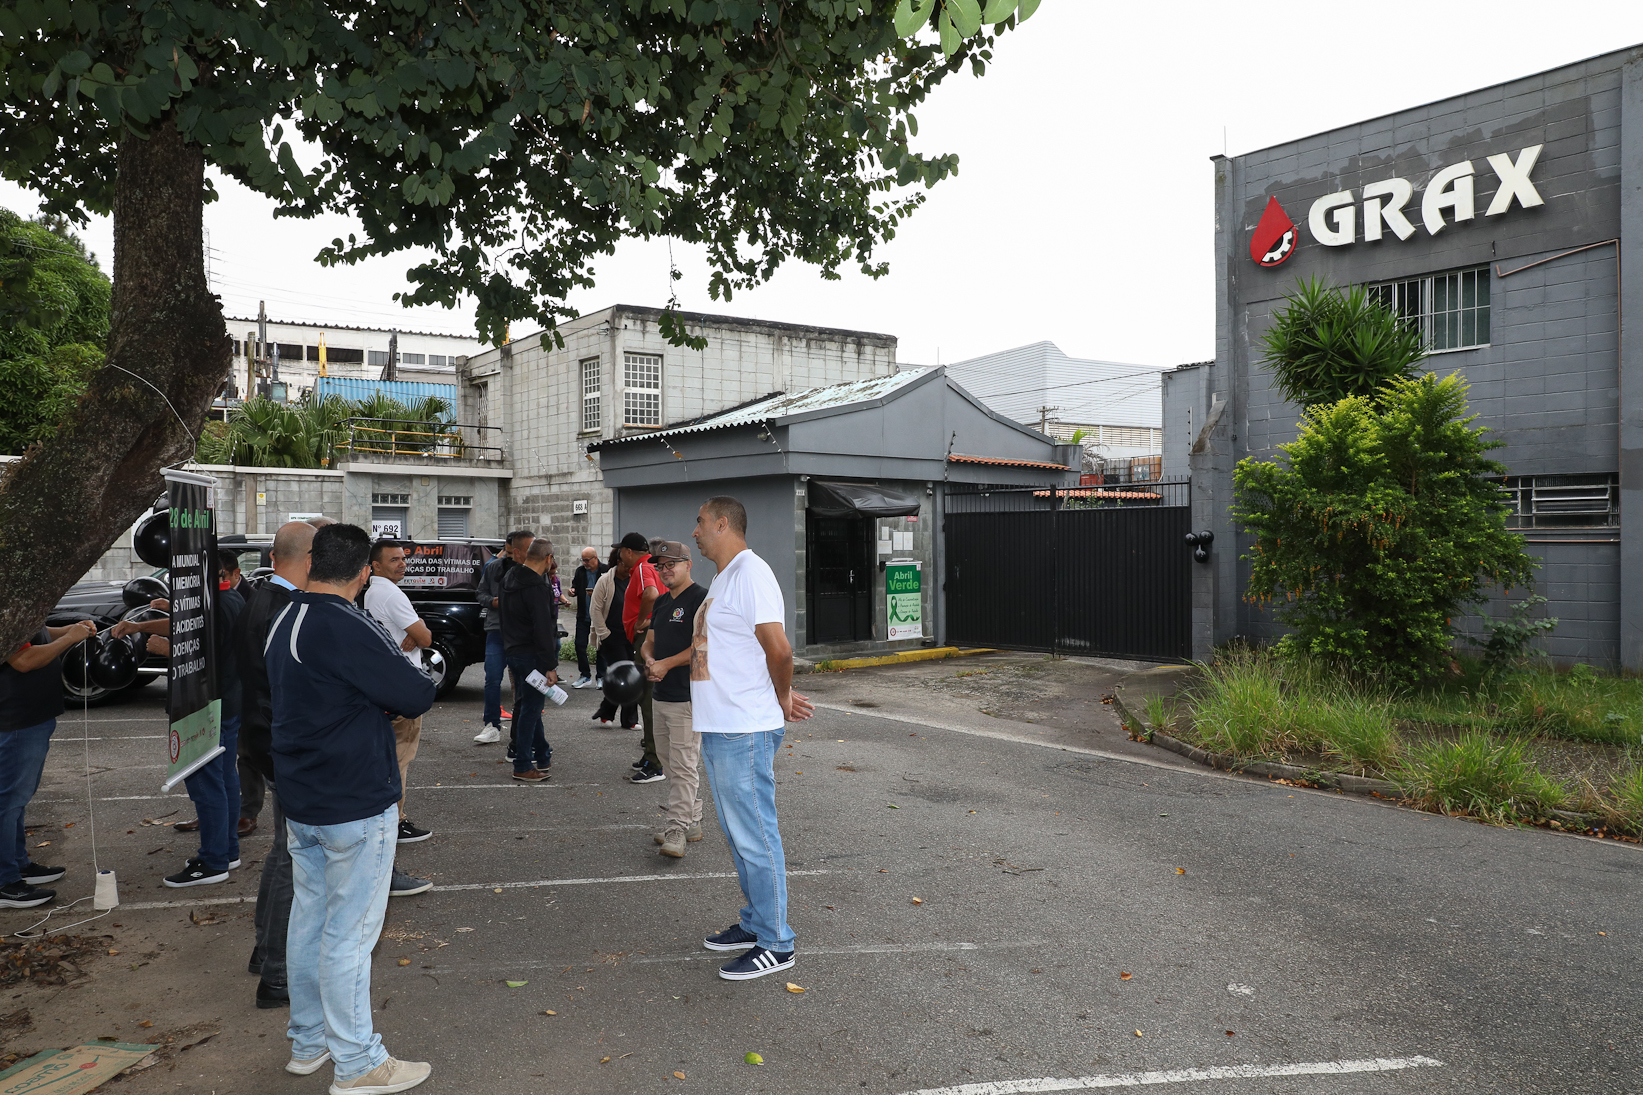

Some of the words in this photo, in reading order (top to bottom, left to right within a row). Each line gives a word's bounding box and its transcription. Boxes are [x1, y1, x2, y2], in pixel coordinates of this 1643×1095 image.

[1308, 144, 1545, 247] GRAX
[169, 507, 178, 528] 28
[181, 508, 192, 528] de
[383, 524, 399, 533] 692
[414, 546, 443, 555] Abril
[177, 554, 200, 568] MUNDIAL
[405, 557, 427, 565] MÓRIA
[444, 557, 471, 566] VÍTIMAS
[437, 566, 474, 574] TRABALHO
[894, 571, 912, 580] Abril
[176, 573, 200, 590] MEMÓRIA
[889, 580, 919, 590] Verde
[180, 595, 200, 612] VÍTIMAS
[173, 638, 200, 658] DOENÇAS
[178, 657, 206, 678] TRABALHO
